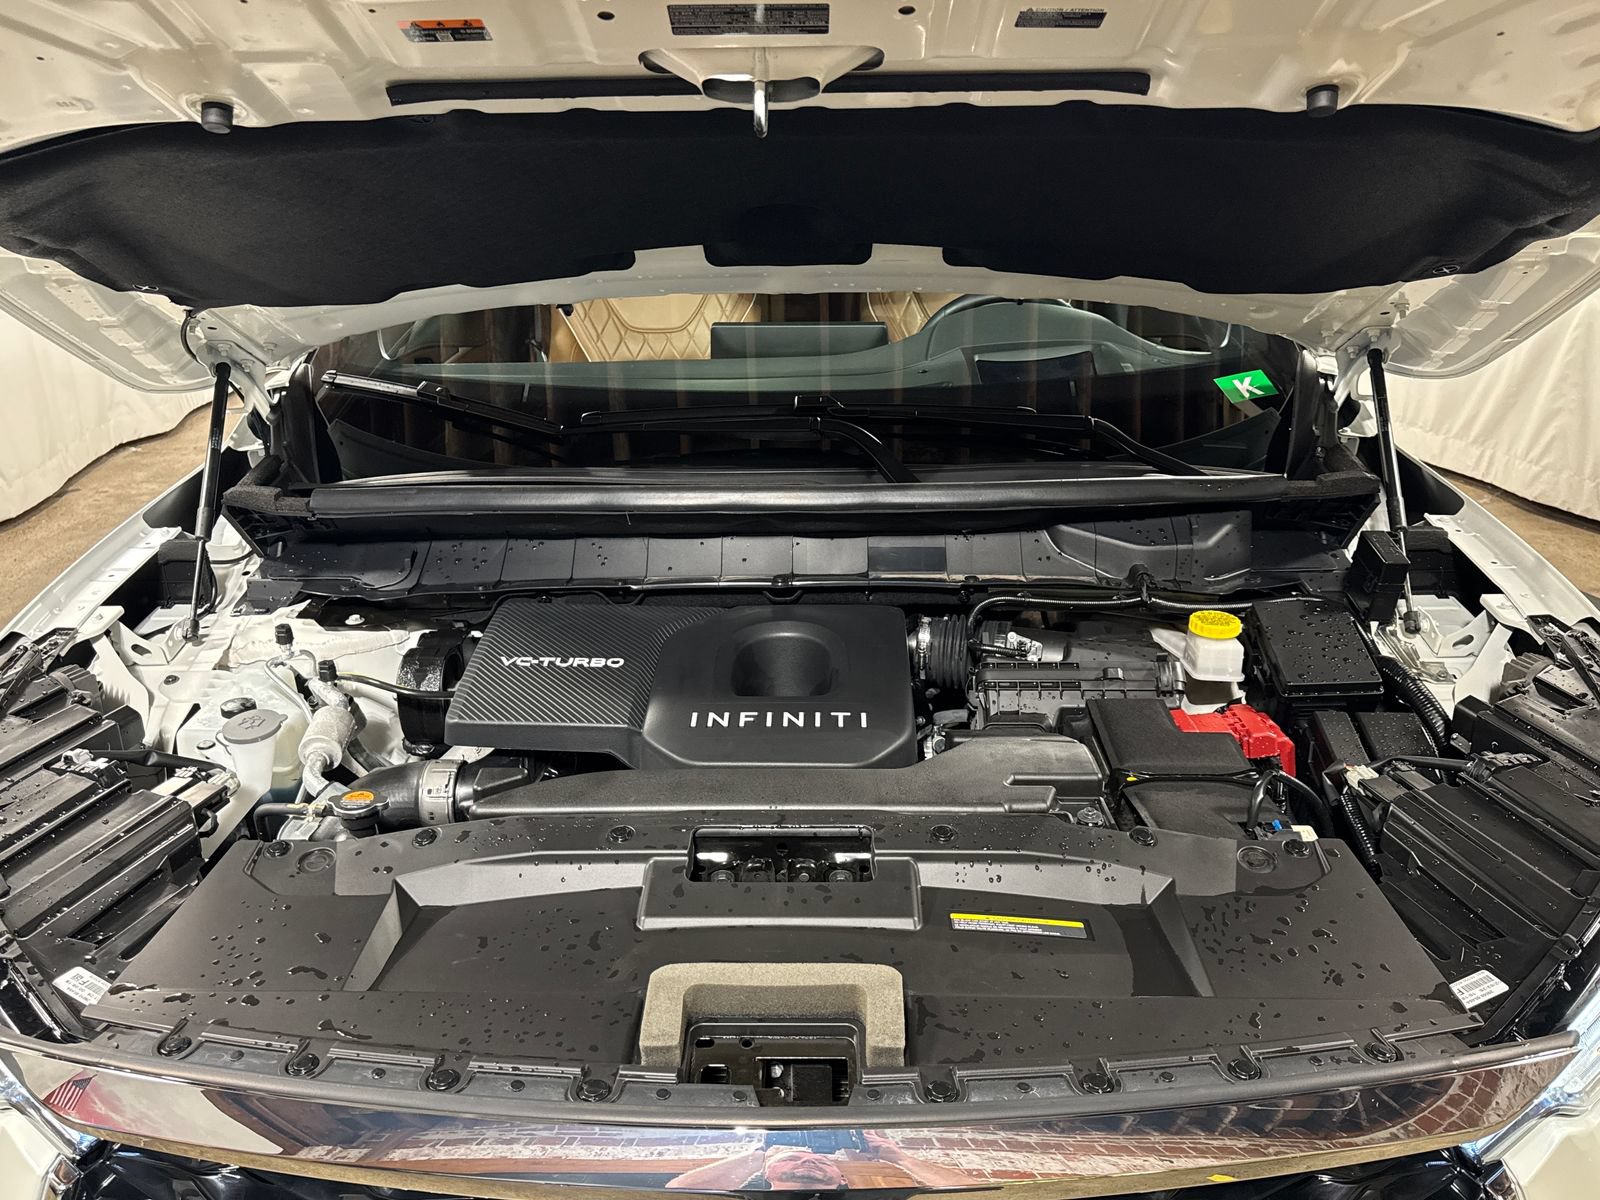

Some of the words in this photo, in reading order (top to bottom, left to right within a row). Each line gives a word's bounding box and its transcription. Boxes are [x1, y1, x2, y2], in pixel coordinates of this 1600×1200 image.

[1232, 376, 1265, 399] K
[500, 656, 625, 668] VC-TURBO
[690, 711, 868, 728] INFINITI
